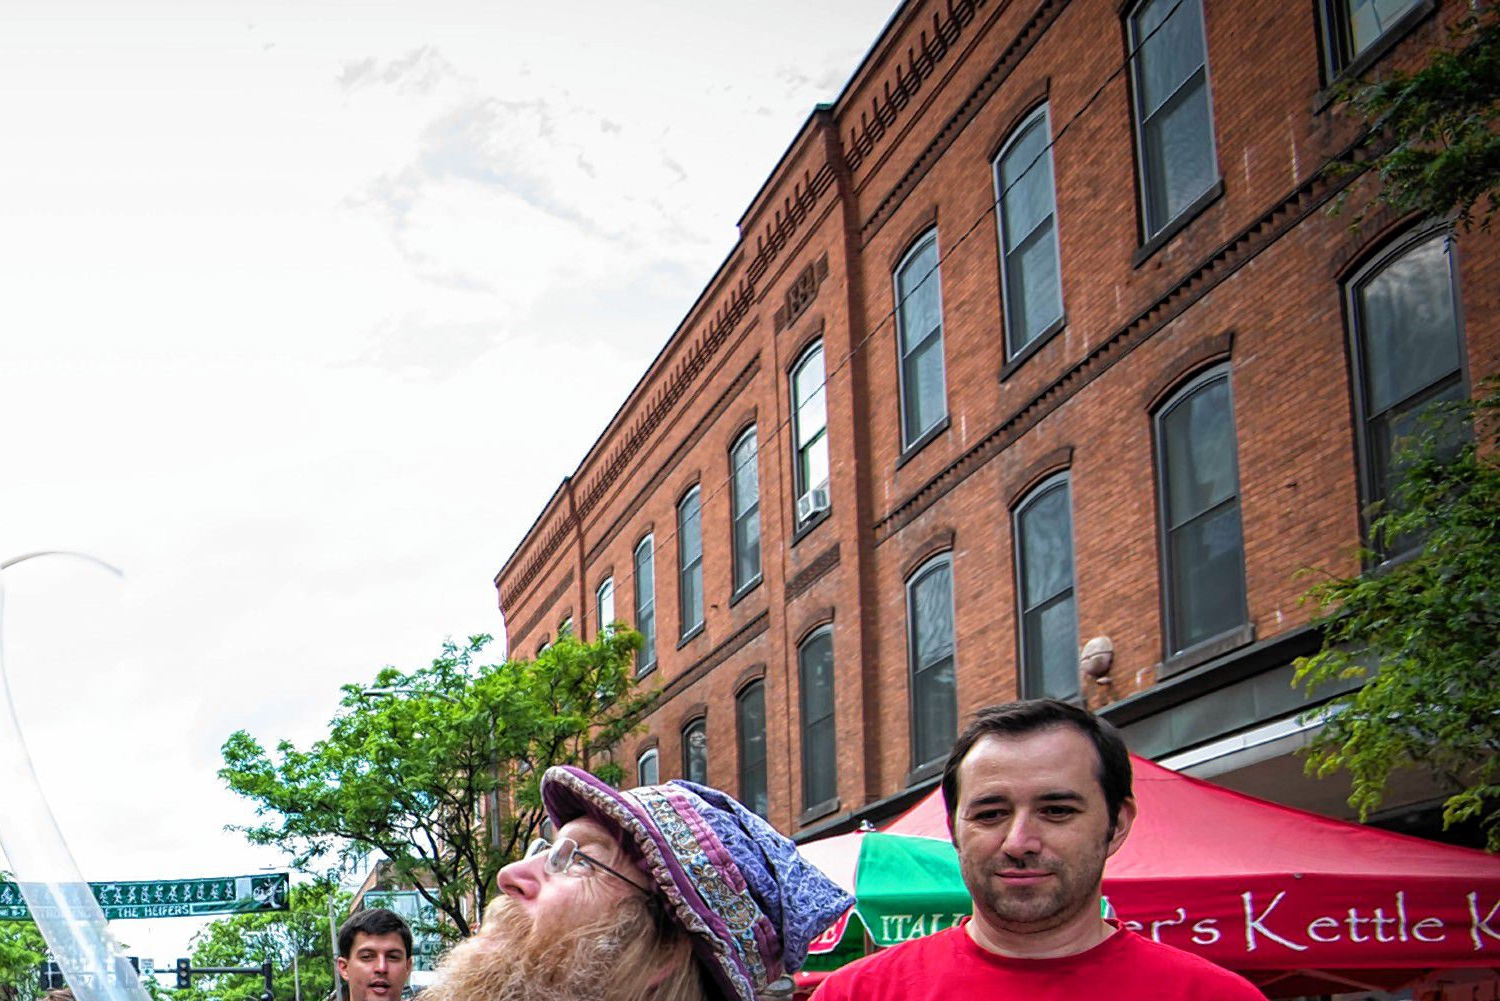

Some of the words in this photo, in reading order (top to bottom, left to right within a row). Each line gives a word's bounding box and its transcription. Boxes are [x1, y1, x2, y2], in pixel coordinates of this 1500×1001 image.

[117, 907, 139, 918] THE
[144, 904, 190, 917] HEIFERS
[1241, 890, 1446, 951] Kettle
